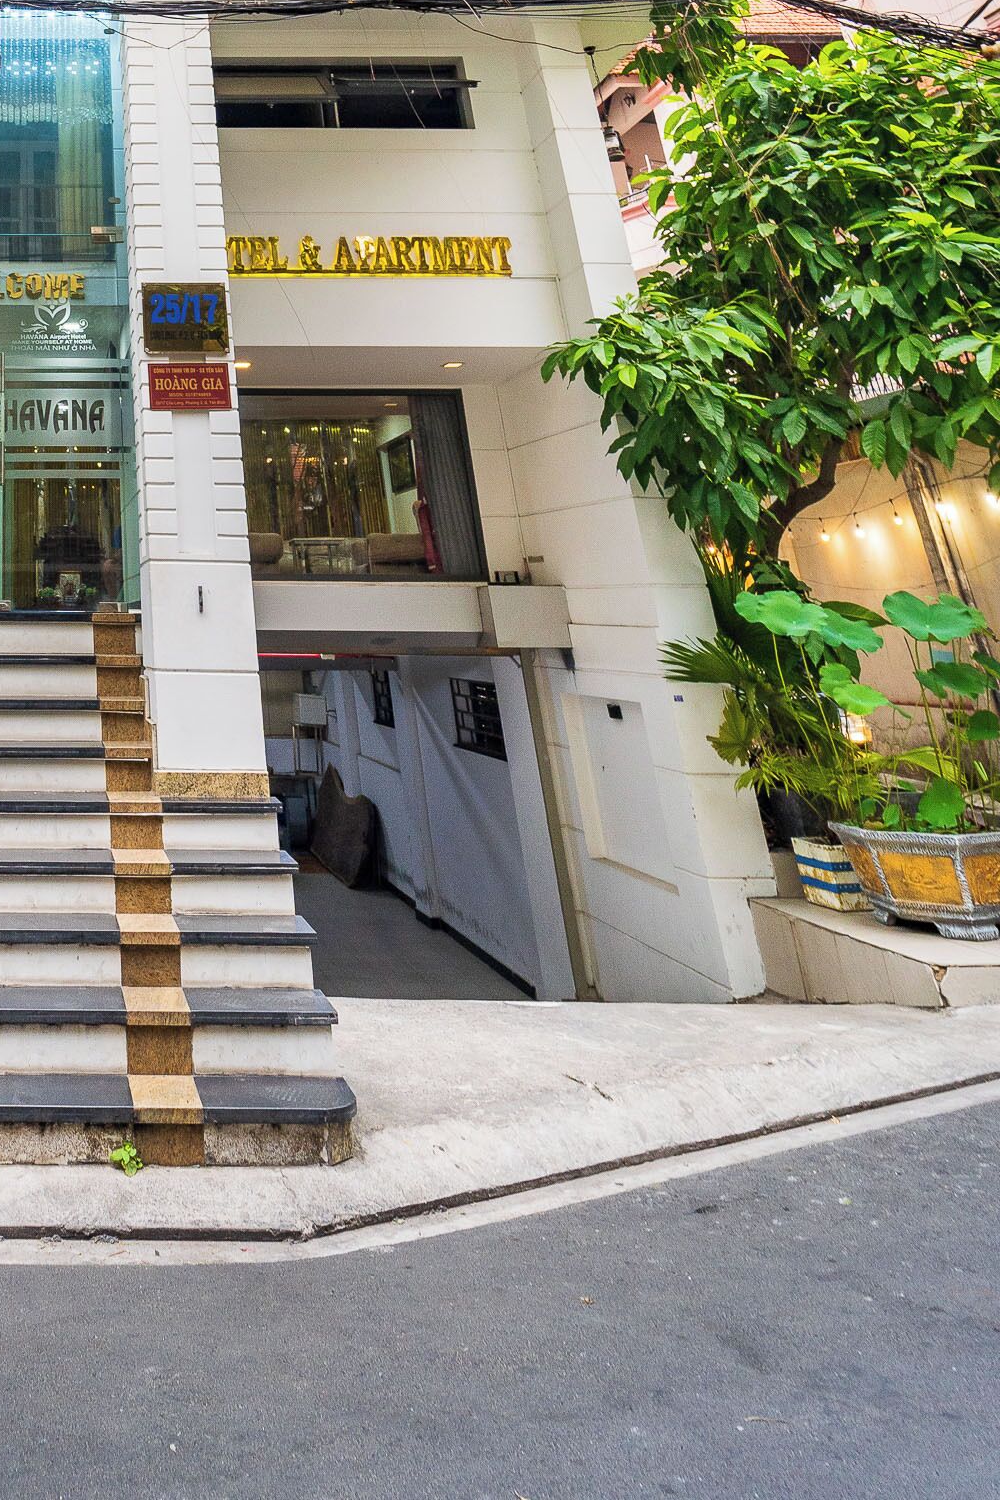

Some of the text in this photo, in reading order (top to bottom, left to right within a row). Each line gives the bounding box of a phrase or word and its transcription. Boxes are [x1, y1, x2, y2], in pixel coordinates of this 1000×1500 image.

[300, 235, 322, 270] &
[334, 236, 512, 271] APARTMENT
[149, 292, 219, 325] 25/17
[49, 333, 70, 341] Airport
[155, 375, 224, 390] HOÀNG GIA
[3, 400, 105, 434] HAVANA
